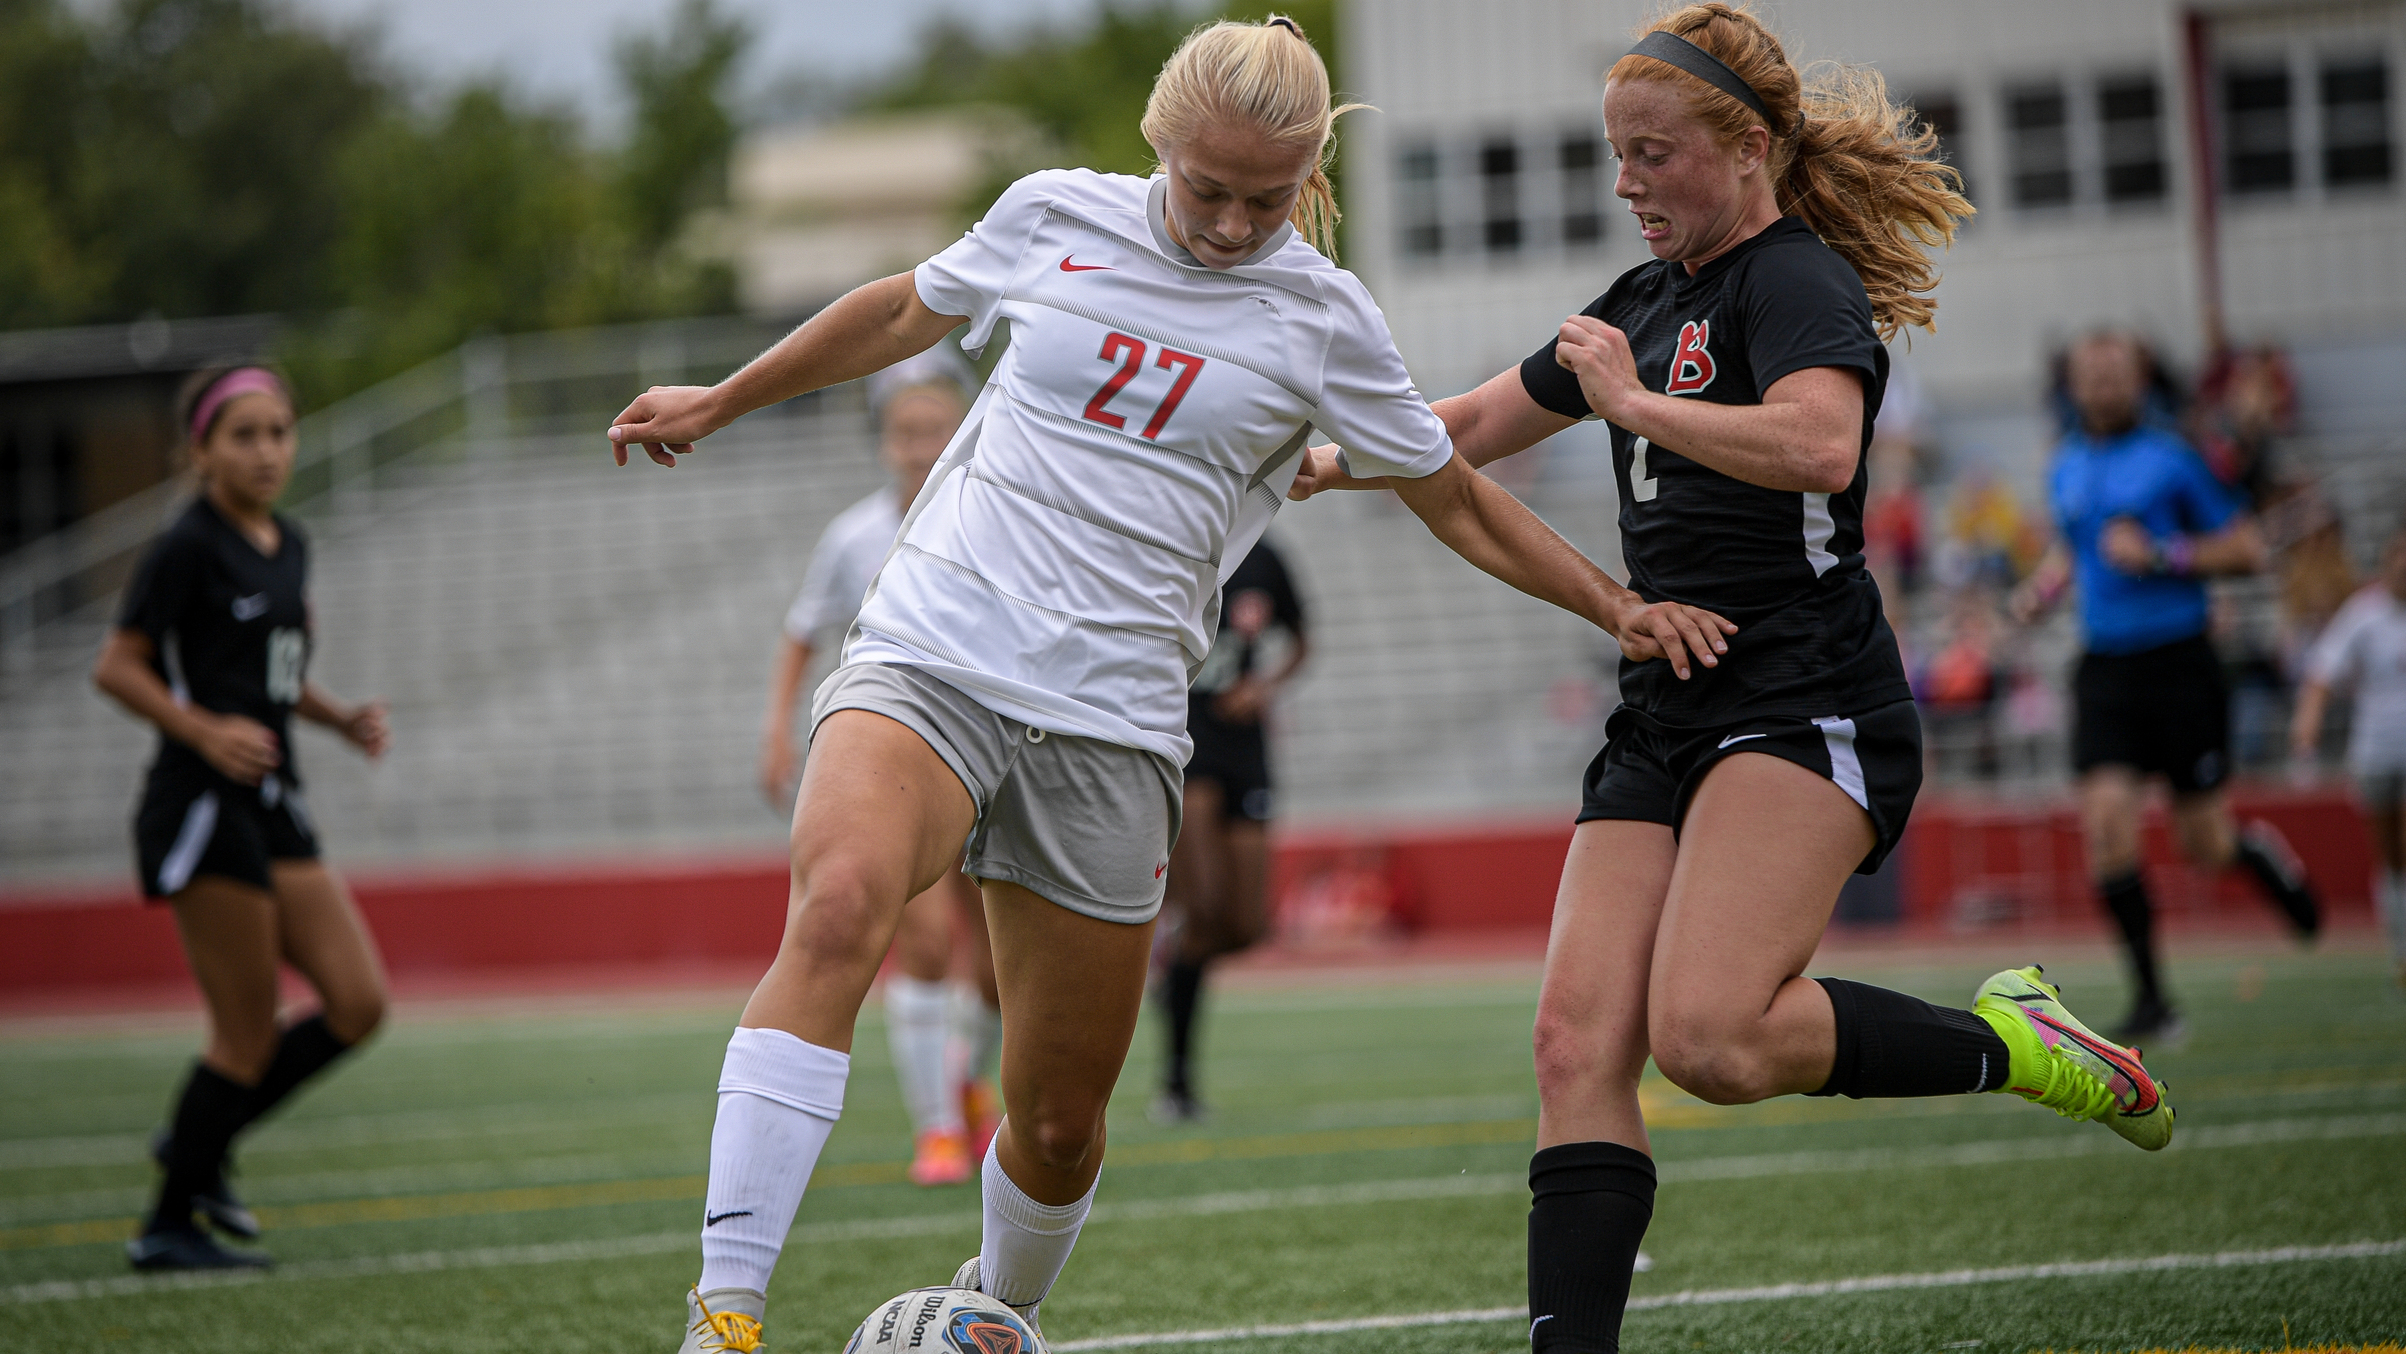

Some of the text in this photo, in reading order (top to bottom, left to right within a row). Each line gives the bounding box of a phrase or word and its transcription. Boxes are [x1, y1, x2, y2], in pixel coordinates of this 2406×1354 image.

[1081, 331, 1206, 441] 27
[1665, 319, 1717, 396] B
[876, 1300, 907, 1344] NCAA
[909, 1296, 945, 1348] Wilson
